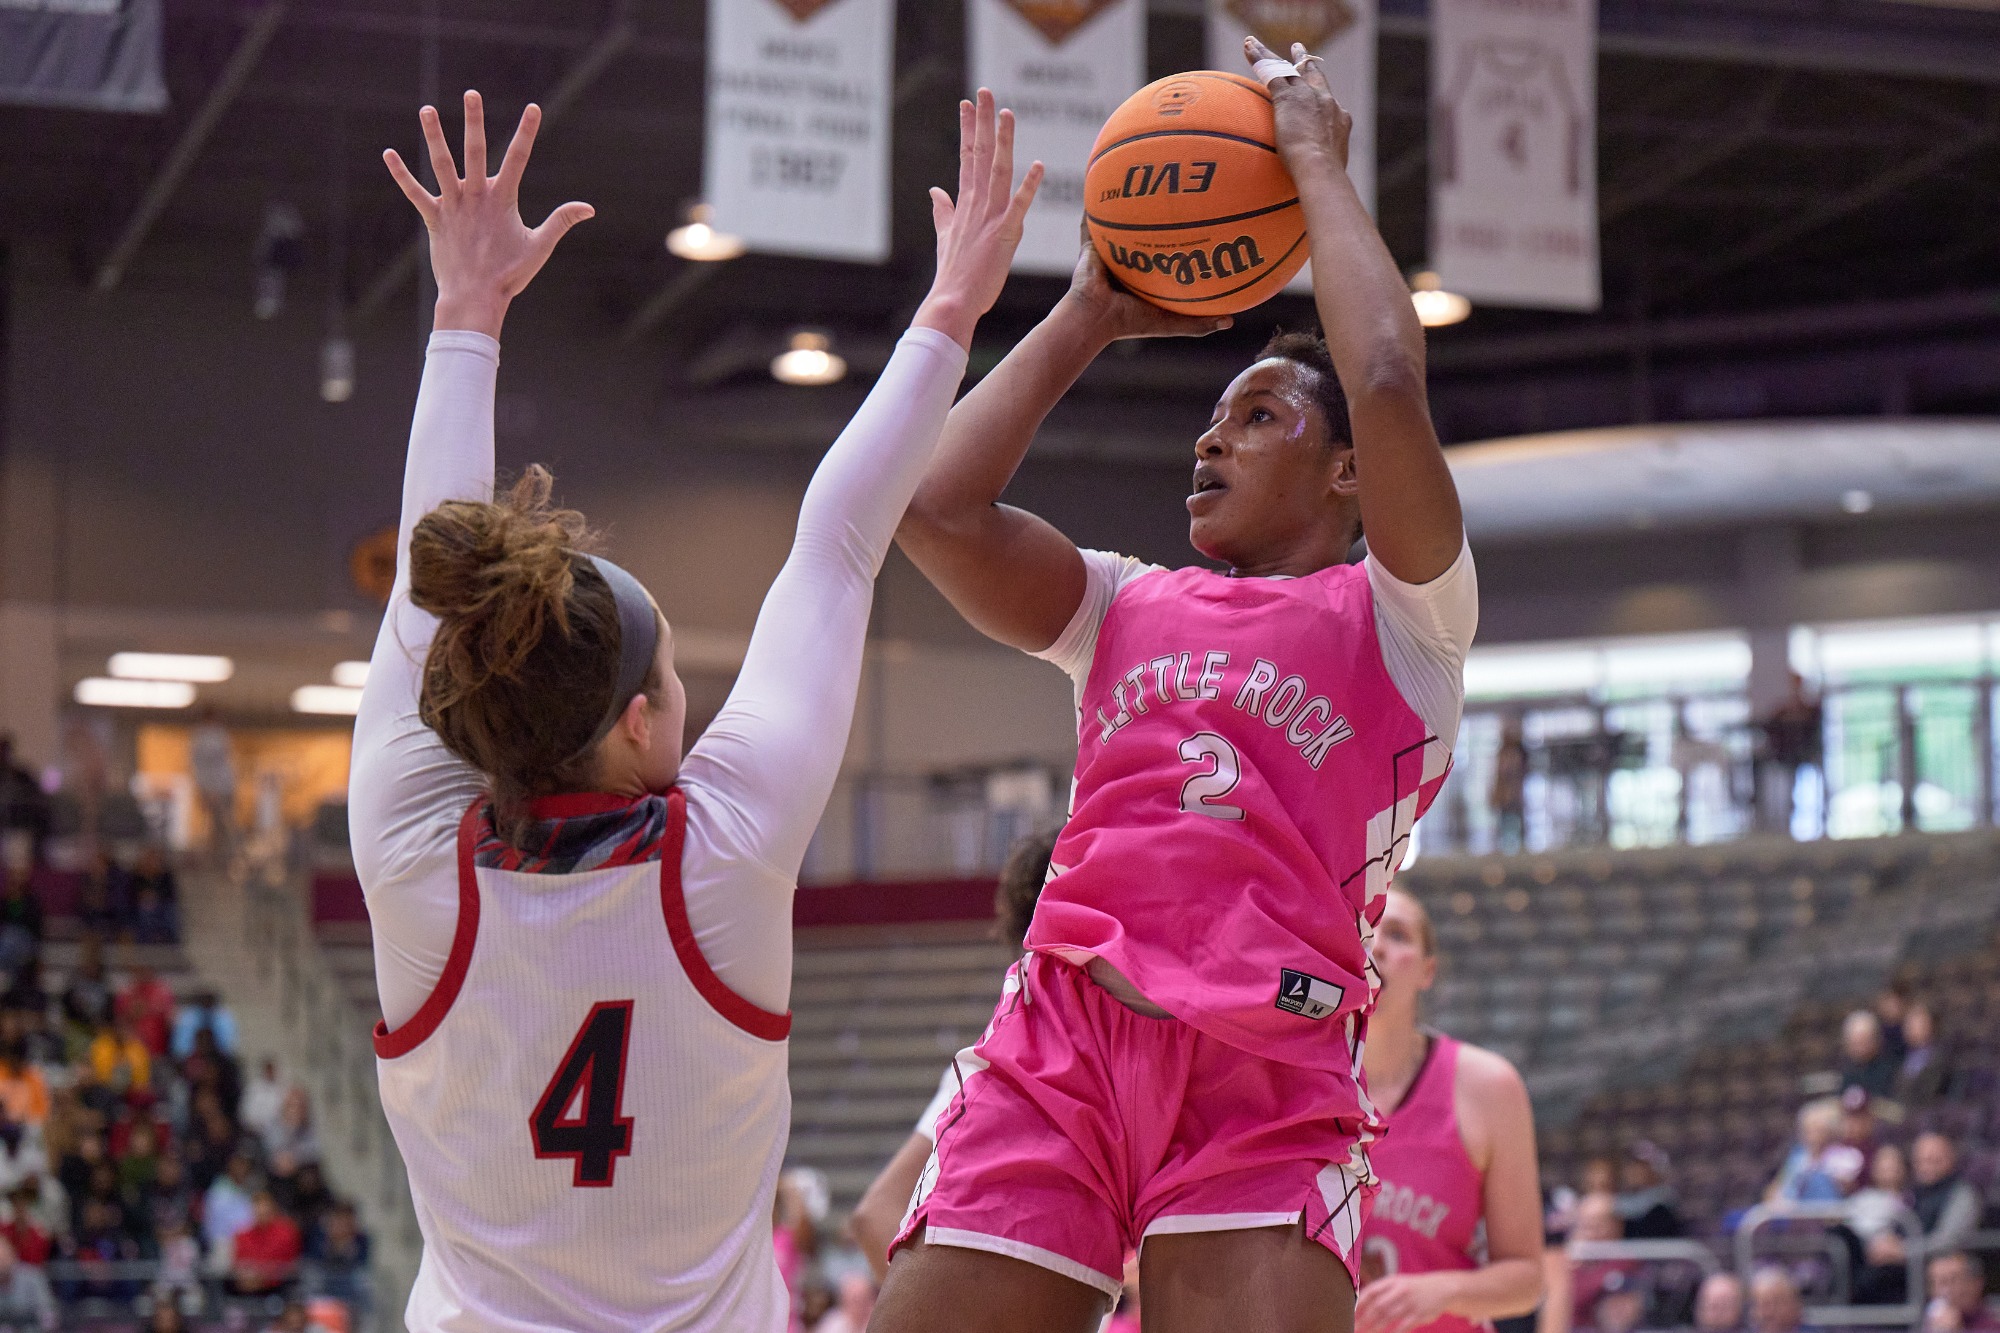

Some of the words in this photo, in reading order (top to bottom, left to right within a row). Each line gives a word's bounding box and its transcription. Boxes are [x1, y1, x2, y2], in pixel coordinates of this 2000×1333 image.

[1100, 187, 1121, 203] NXT
[1121, 161, 1218, 199] EVO
[1108, 235, 1265, 286] Wilson
[1096, 650, 1230, 744] LITTLE
[1232, 657, 1355, 771] ROCK
[1177, 731, 1246, 822] 2
[1310, 1004, 1324, 1015] M
[528, 998, 635, 1188] 4
[1372, 1180, 1450, 1240] ROCK
